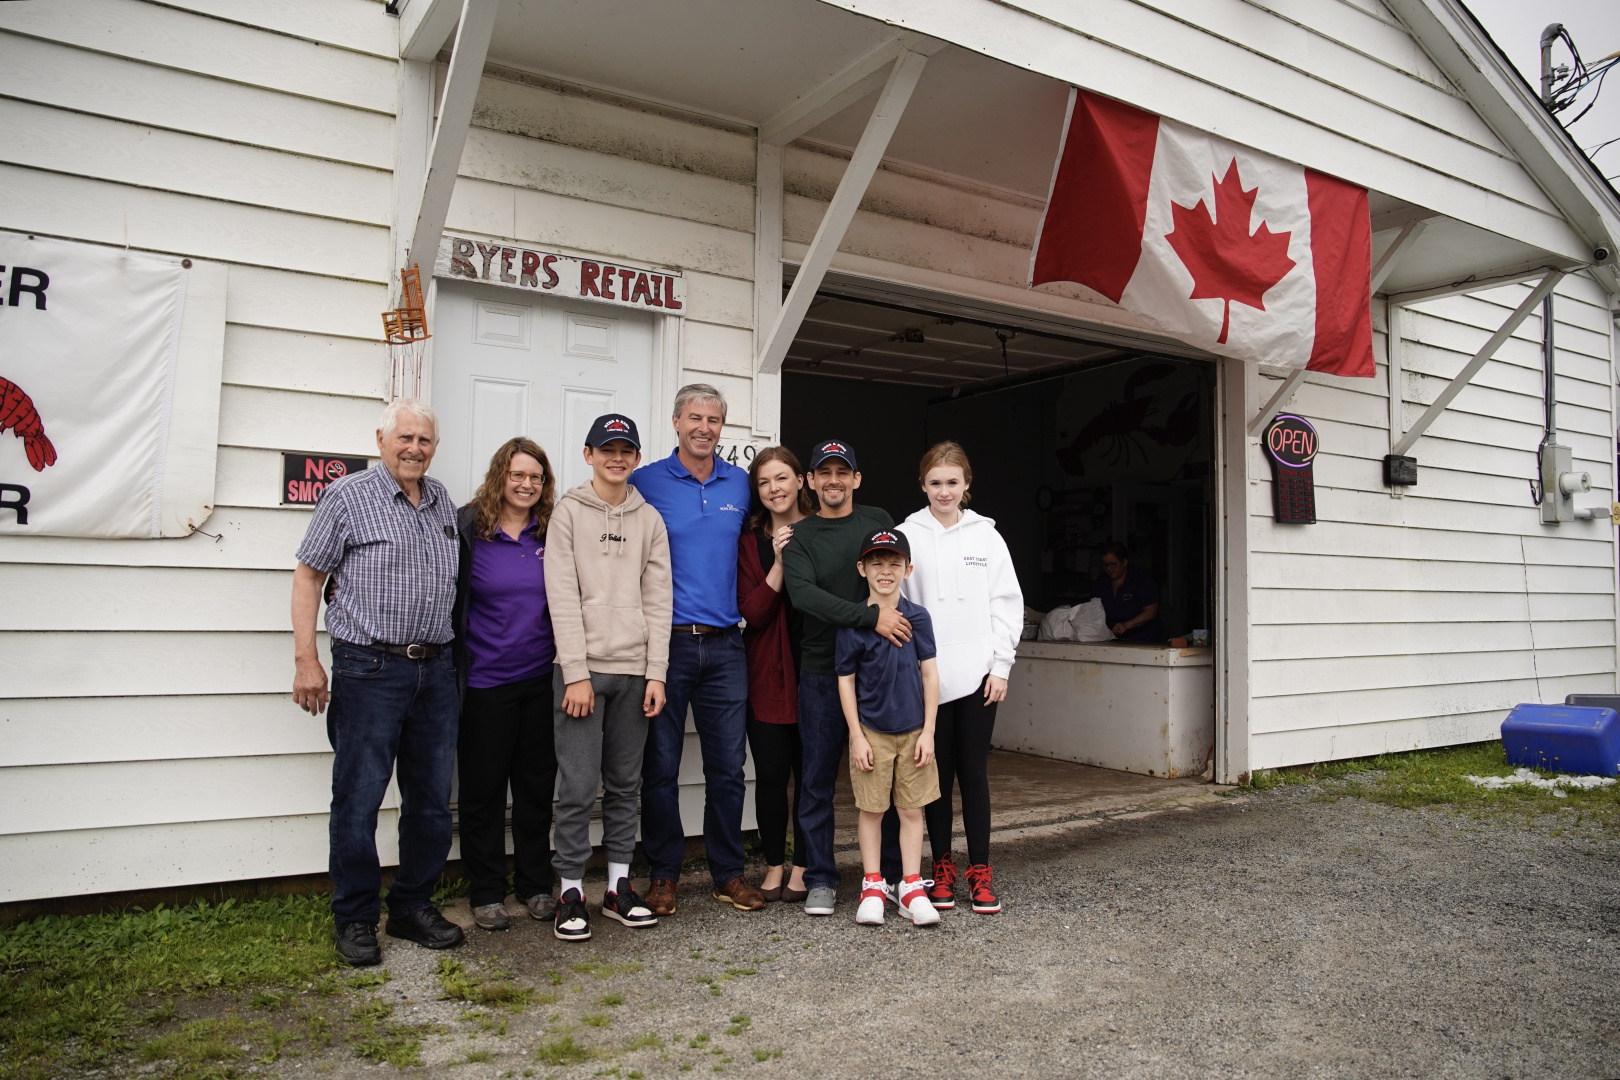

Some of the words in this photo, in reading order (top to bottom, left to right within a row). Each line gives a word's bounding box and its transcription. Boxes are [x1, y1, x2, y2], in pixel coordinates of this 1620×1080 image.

[0, 265, 50, 311] R
[450, 237, 560, 290] RYERS
[580, 260, 683, 310] RETAIL
[1271, 428, 1313, 455] OPEN
[287, 479, 328, 502] SMO
